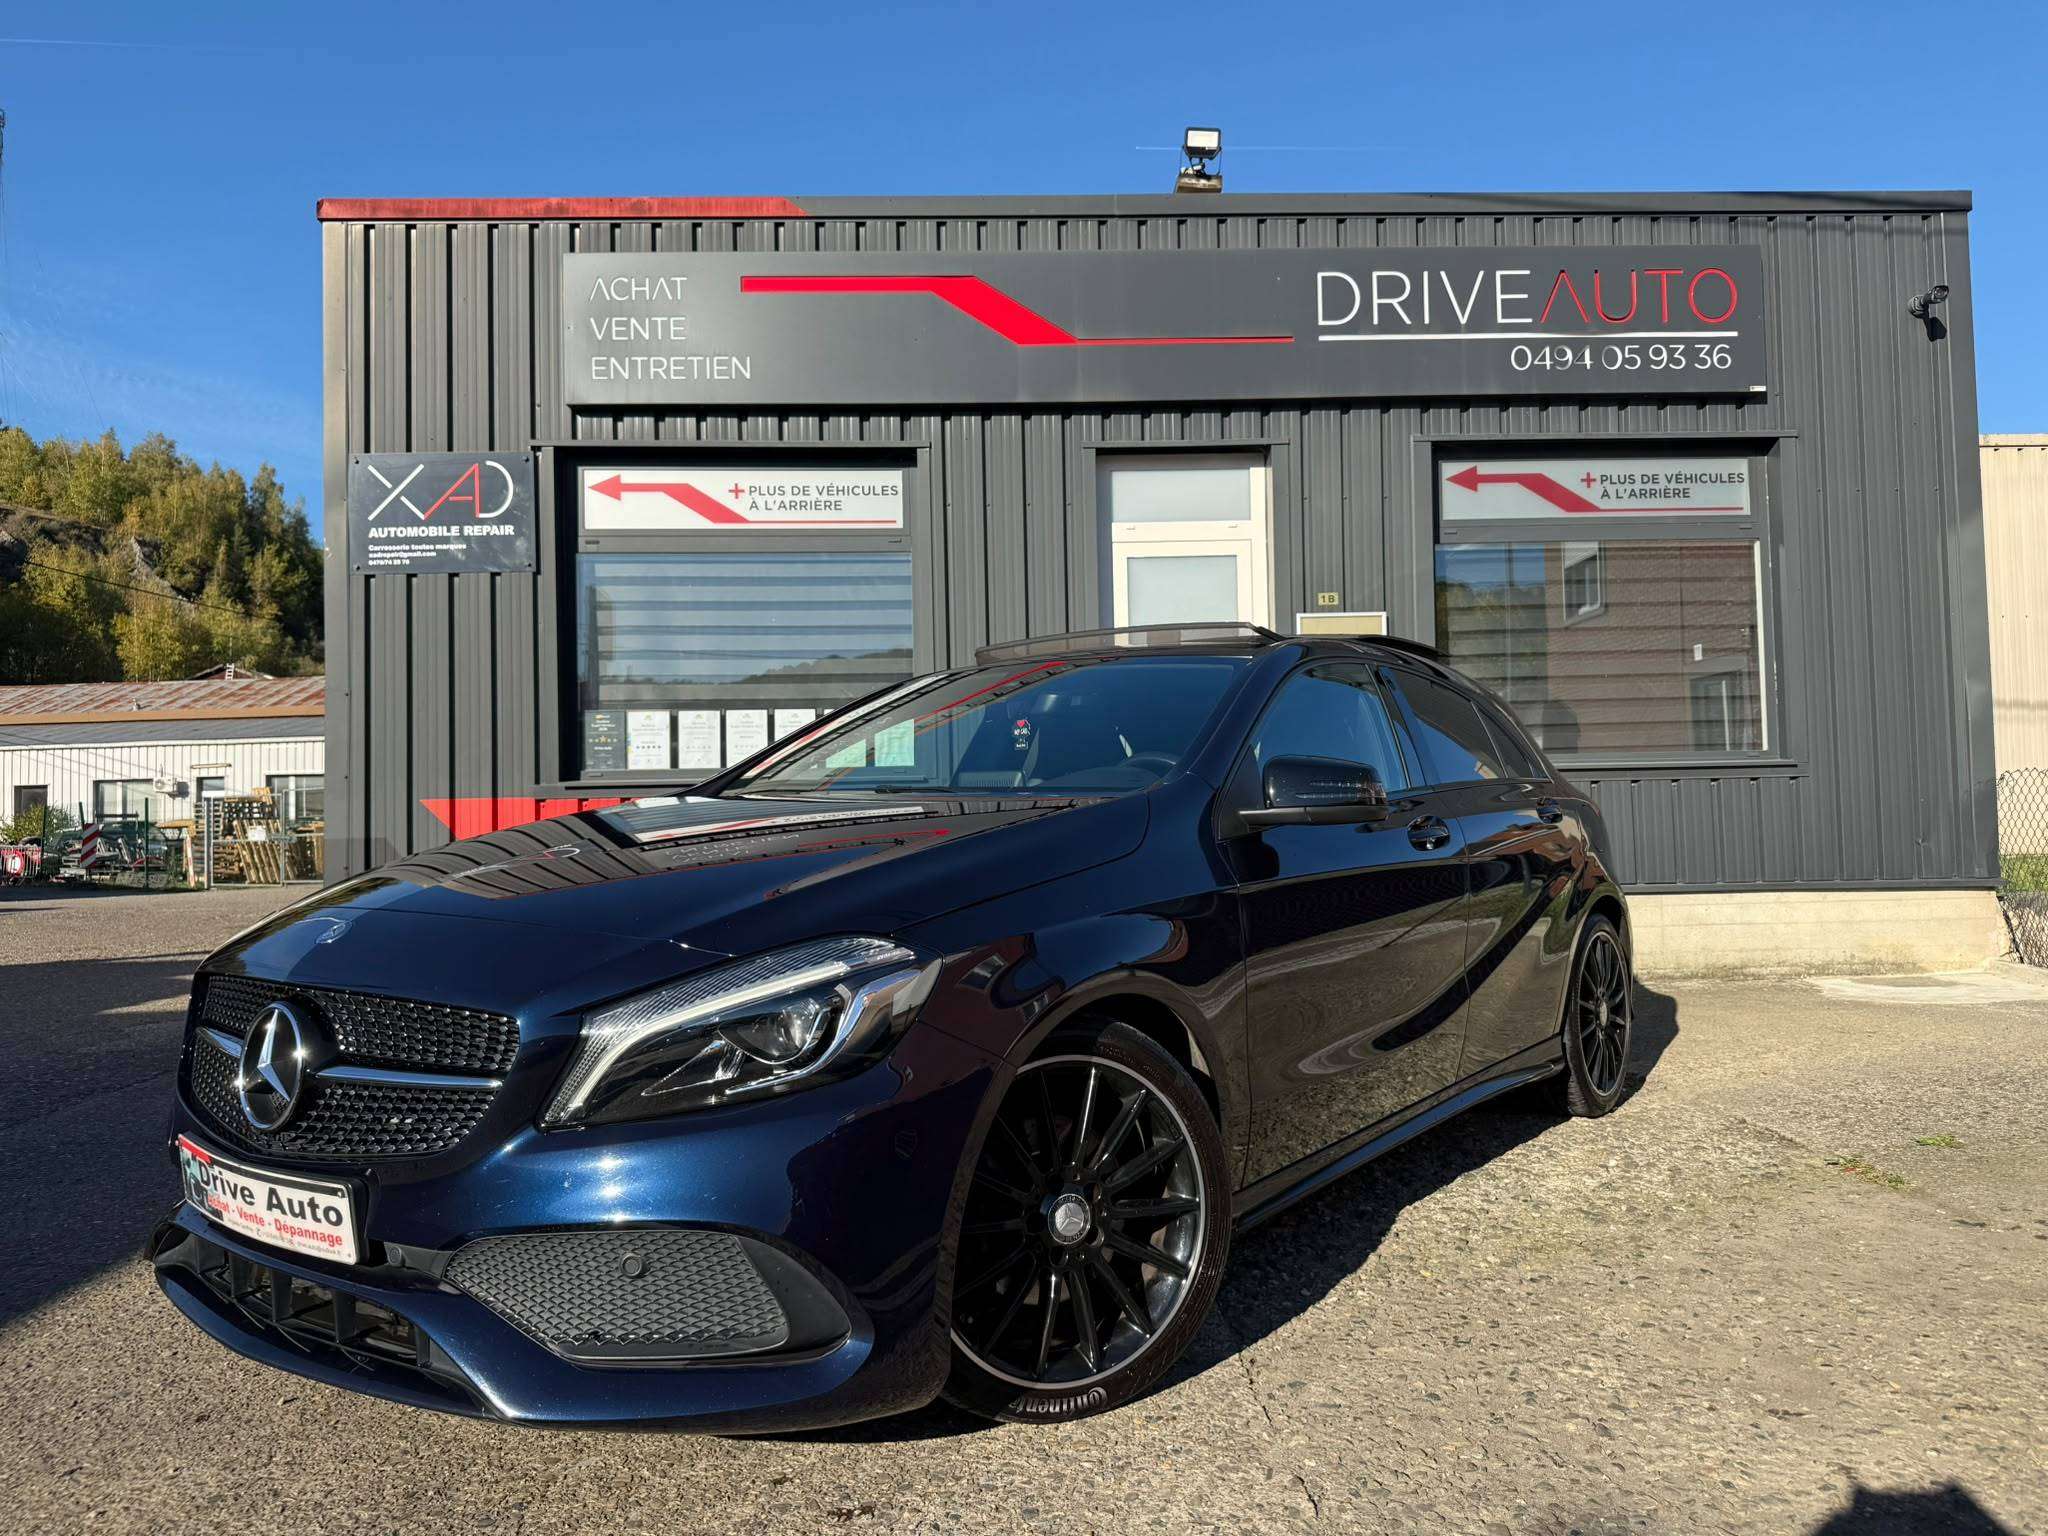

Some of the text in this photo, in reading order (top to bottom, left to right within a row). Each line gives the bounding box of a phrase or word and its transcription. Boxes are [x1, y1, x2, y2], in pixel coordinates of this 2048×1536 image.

[590, 277, 688, 301] ACHAT
[590, 316, 687, 341] VENTE
[1510, 343, 1733, 371] 0494 05 93 36
[591, 356, 752, 380] ENTRETIEN
[1600, 473, 1636, 485] PLUS
[1640, 473, 1661, 485] DE
[1664, 471, 1746, 485] VÉHICULES
[749, 485, 786, 497] PLUS
[791, 485, 812, 497] DE
[815, 482, 899, 497] VÉHICULES
[1600, 485, 1691, 500] À L'ARRIÈRE
[749, 497, 844, 511] À L'ARRIÈRE
[368, 525, 515, 539] AUTOMOBILE REPAIR
[1320, 594, 1336, 604] 1B
[199, 1160, 344, 1228] Drive Auto
[236, 1206, 266, 1227] Vente
